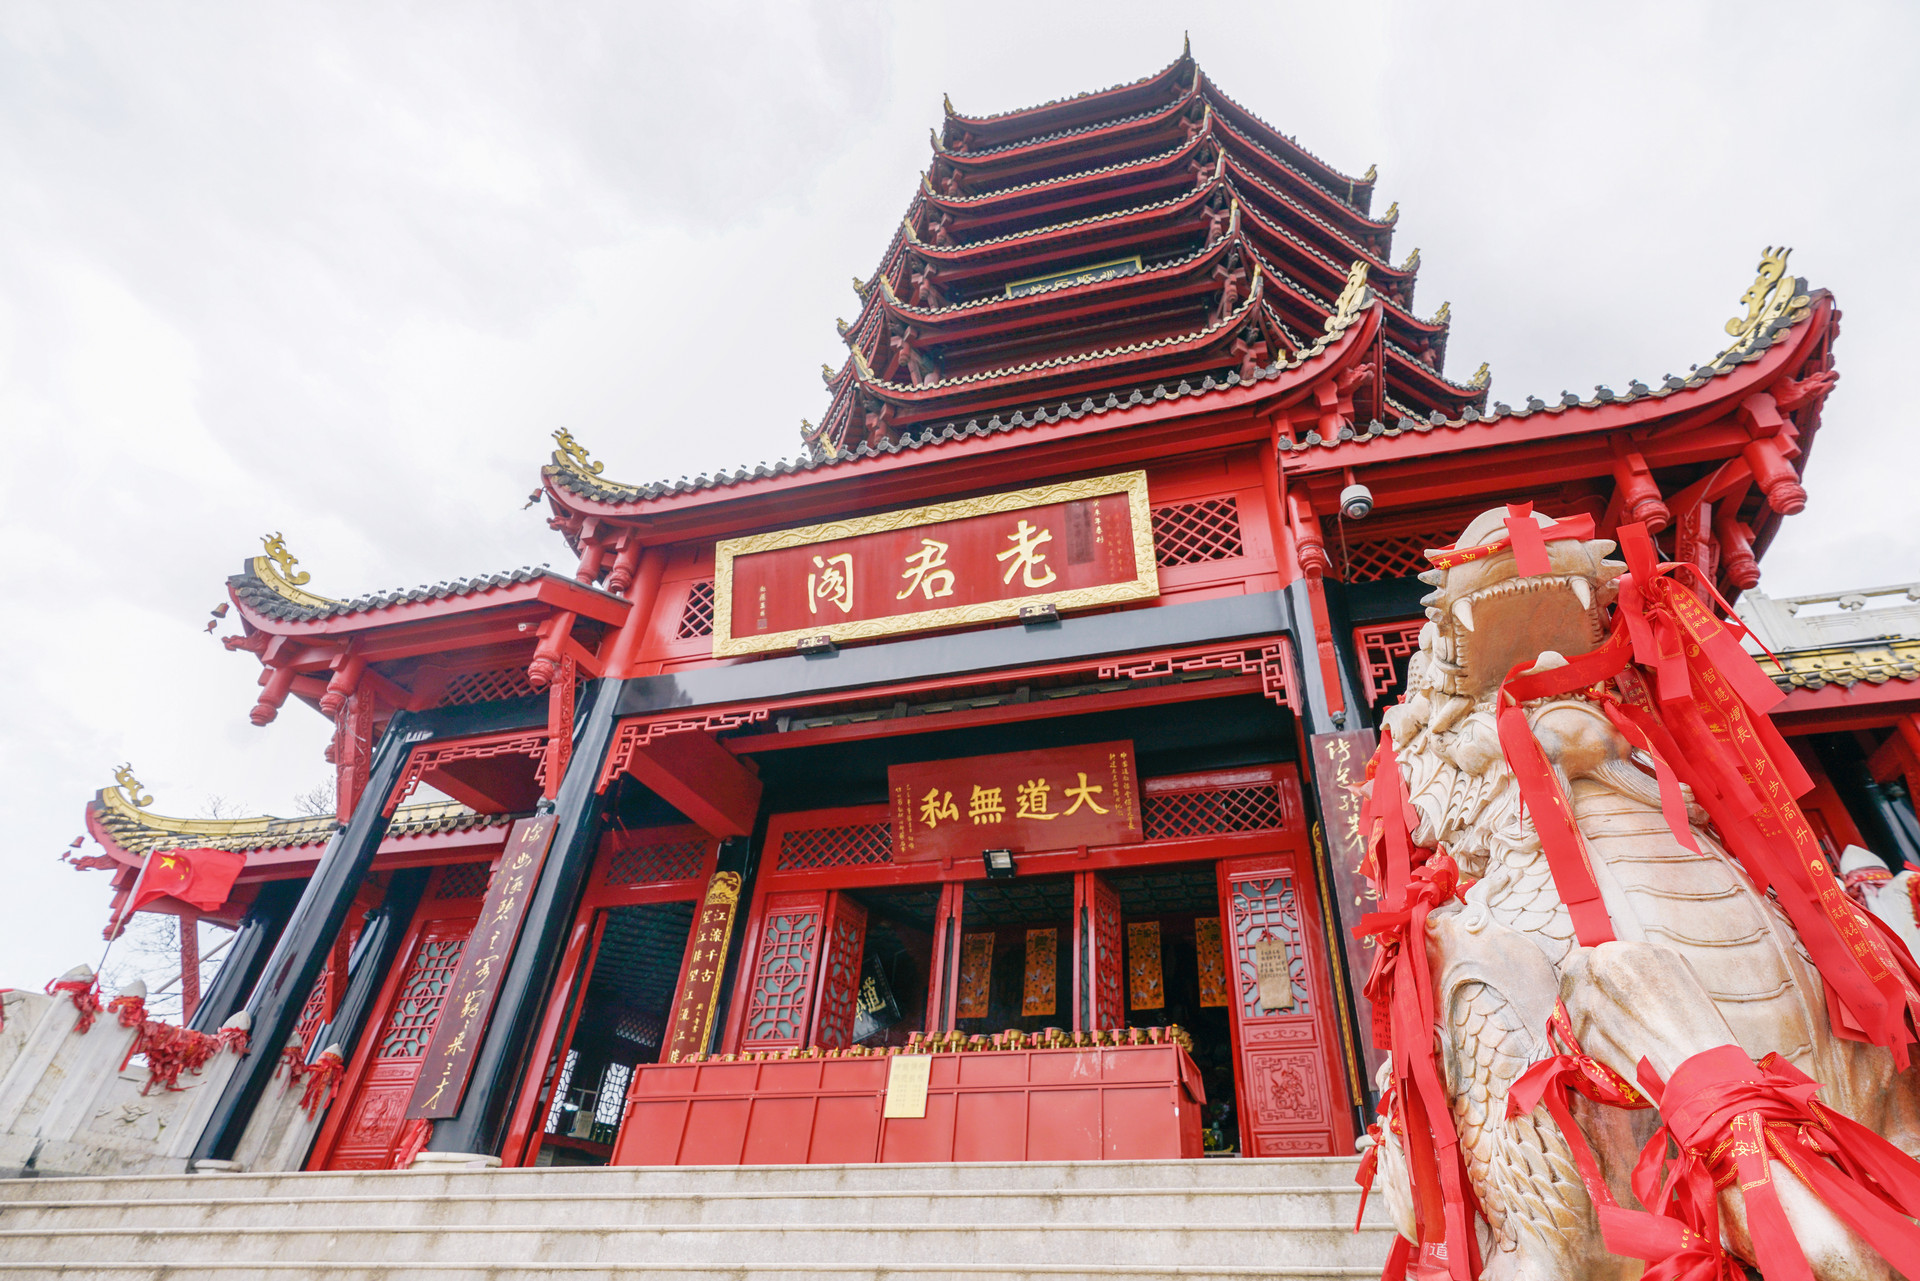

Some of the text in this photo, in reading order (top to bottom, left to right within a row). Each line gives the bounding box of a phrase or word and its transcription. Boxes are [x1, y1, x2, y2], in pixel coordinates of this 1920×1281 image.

[807, 520, 1057, 614] 老君阁
[919, 772, 1110, 829] 大道無私
